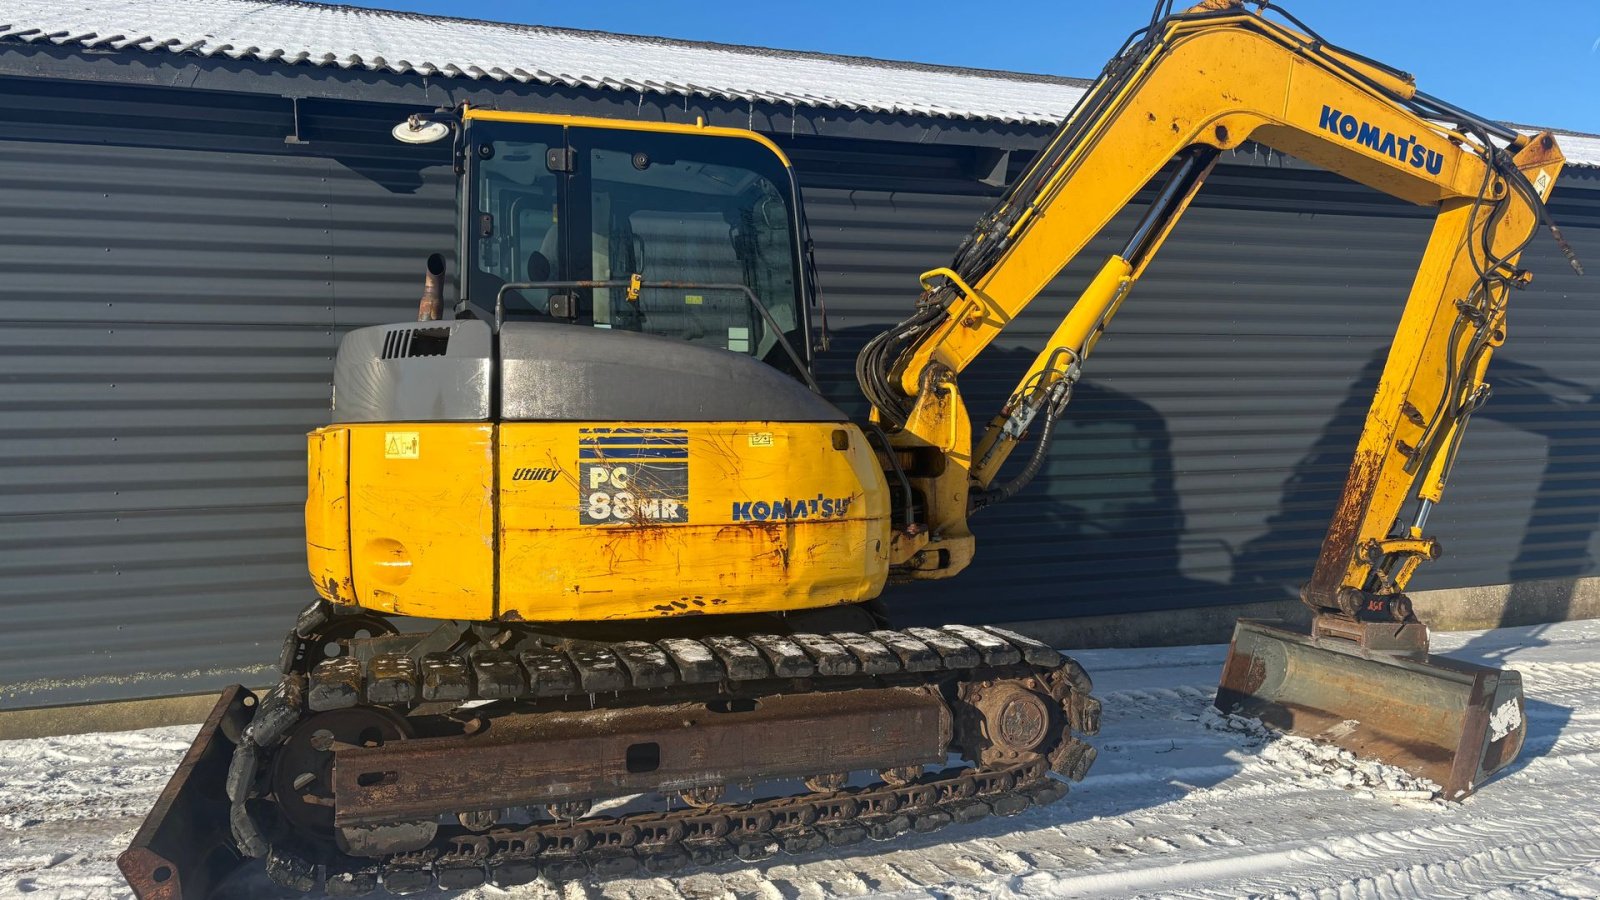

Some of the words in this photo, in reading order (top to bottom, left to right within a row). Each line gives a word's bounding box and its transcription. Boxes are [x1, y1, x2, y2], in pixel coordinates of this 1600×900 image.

[1319, 105, 1444, 175] KOMATSU
[512, 468, 561, 483] Utility
[589, 467, 630, 489] PC
[732, 493, 849, 521] KOMATSU
